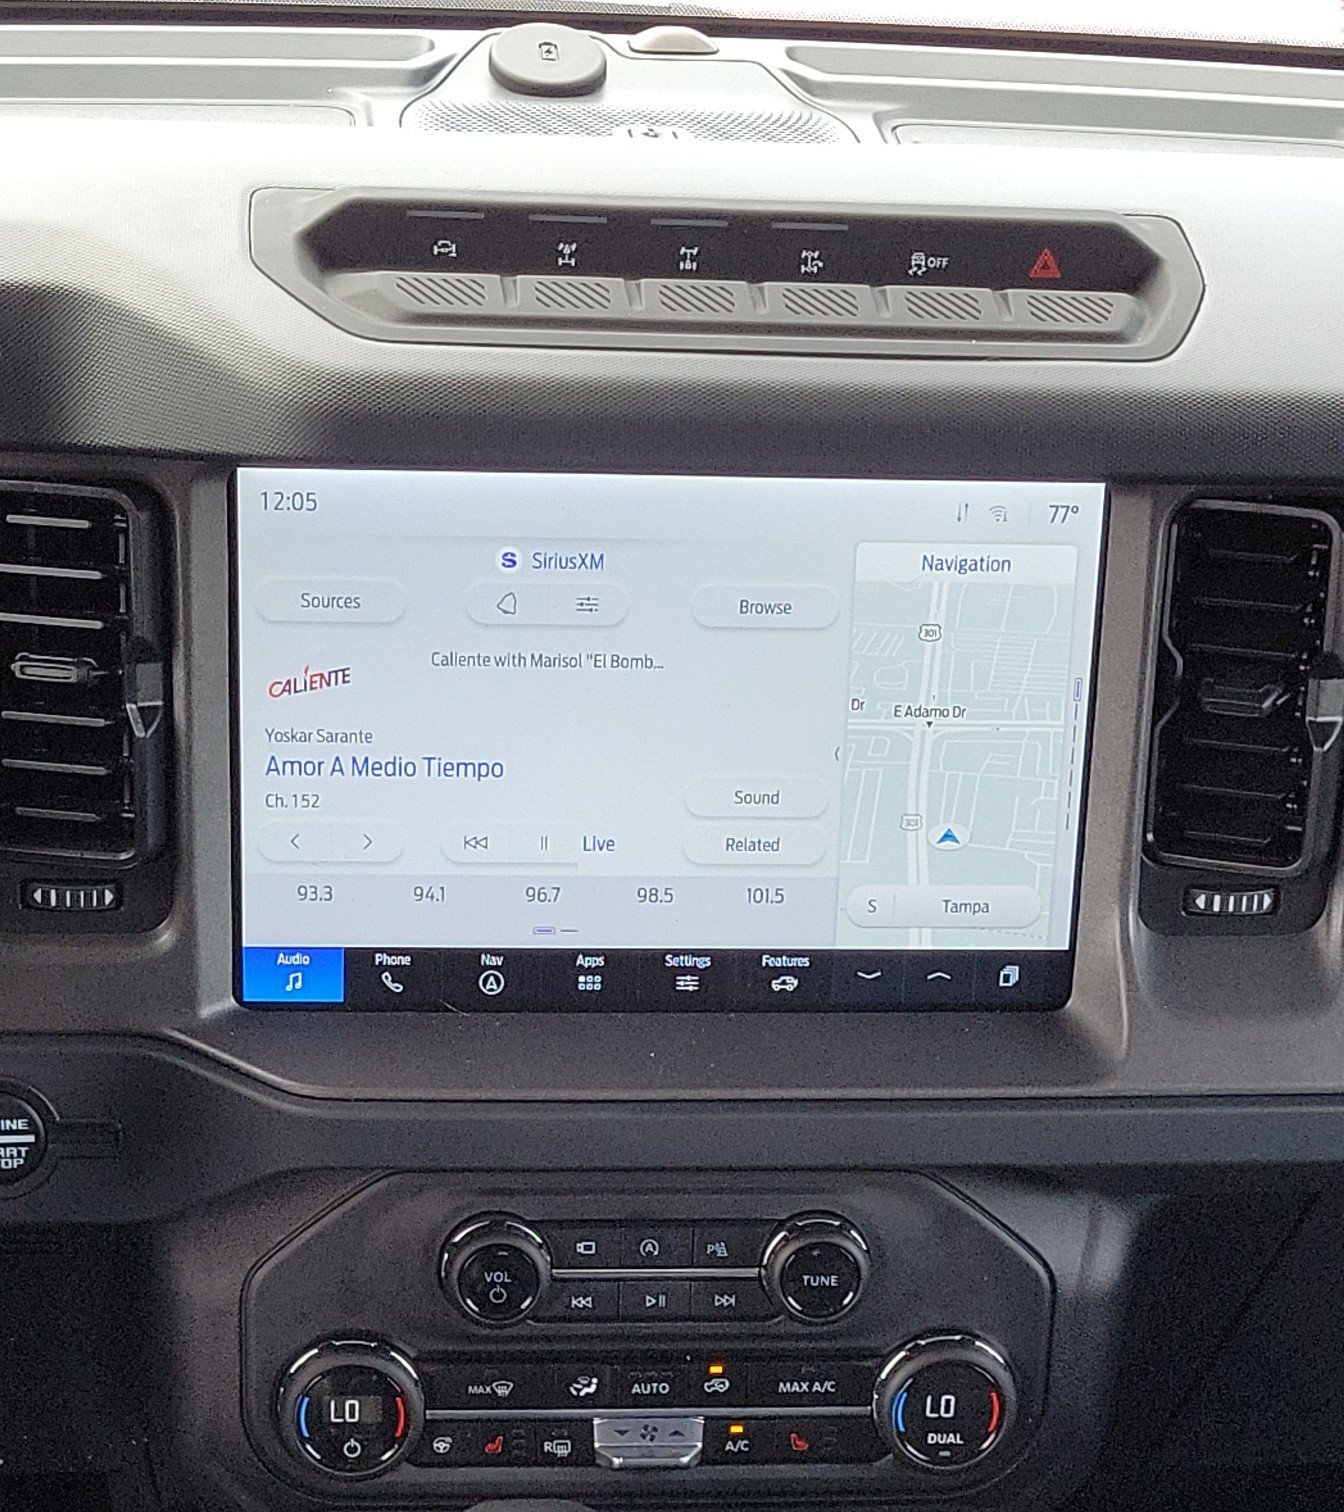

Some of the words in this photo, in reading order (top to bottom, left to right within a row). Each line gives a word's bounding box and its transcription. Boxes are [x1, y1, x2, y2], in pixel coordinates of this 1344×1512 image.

[927, 257, 949, 268] OFF
[260, 491, 318, 512] 12:05
[1049, 504, 1080, 524] 77°
[531, 552, 605, 571] SiriusXM
[922, 555, 1012, 575] Navigation
[300, 592, 361, 610] Sources
[739, 599, 793, 616] Browse
[431, 652, 491, 668] Caliente
[494, 652, 527, 668] with
[530, 653, 582, 669] Marisol
[851, 698, 865, 711] Dr
[894, 705, 902, 718] E
[904, 704, 950, 718] Adamo
[952, 705, 966, 719] Dr
[265, 728, 313, 745] Yoskar
[316, 729, 373, 745] Sarante
[265, 756, 324, 778] Amor
[330, 756, 345, 778] A
[351, 756, 417, 778] Medio
[422, 757, 504, 783] Tiempo
[265, 794, 288, 809] Ch.
[292, 794, 320, 809] 152
[734, 790, 780, 806] Sound
[583, 836, 616, 853] Live
[725, 837, 780, 854] Related
[297, 886, 334, 902] 93.3
[413, 886, 446, 902] 94.1
[525, 886, 561, 903] 96.7
[637, 887, 674, 904] 98.5
[746, 887, 784, 904] 101.5
[867, 900, 877, 914] S
[942, 900, 990, 916] Tampa
[277, 953, 310, 967] Audio
[375, 953, 411, 967] Phone
[481, 954, 503, 967] Nav
[576, 954, 605, 969] Apps
[664, 954, 711, 969] Settings
[762, 955, 810, 968] Features
[484, 1272, 512, 1284] VOL
[802, 1275, 839, 1287] TUNE
[468, 1384, 492, 1395] MAX
[631, 1382, 670, 1395] AUTO
[778, 1381, 809, 1393] MAX
[812, 1381, 836, 1393] A/C
[330, 1400, 360, 1423] LO
[926, 1395, 955, 1418] LO
[725, 1440, 749, 1452] A/C
[927, 1432, 964, 1445] DUAL
